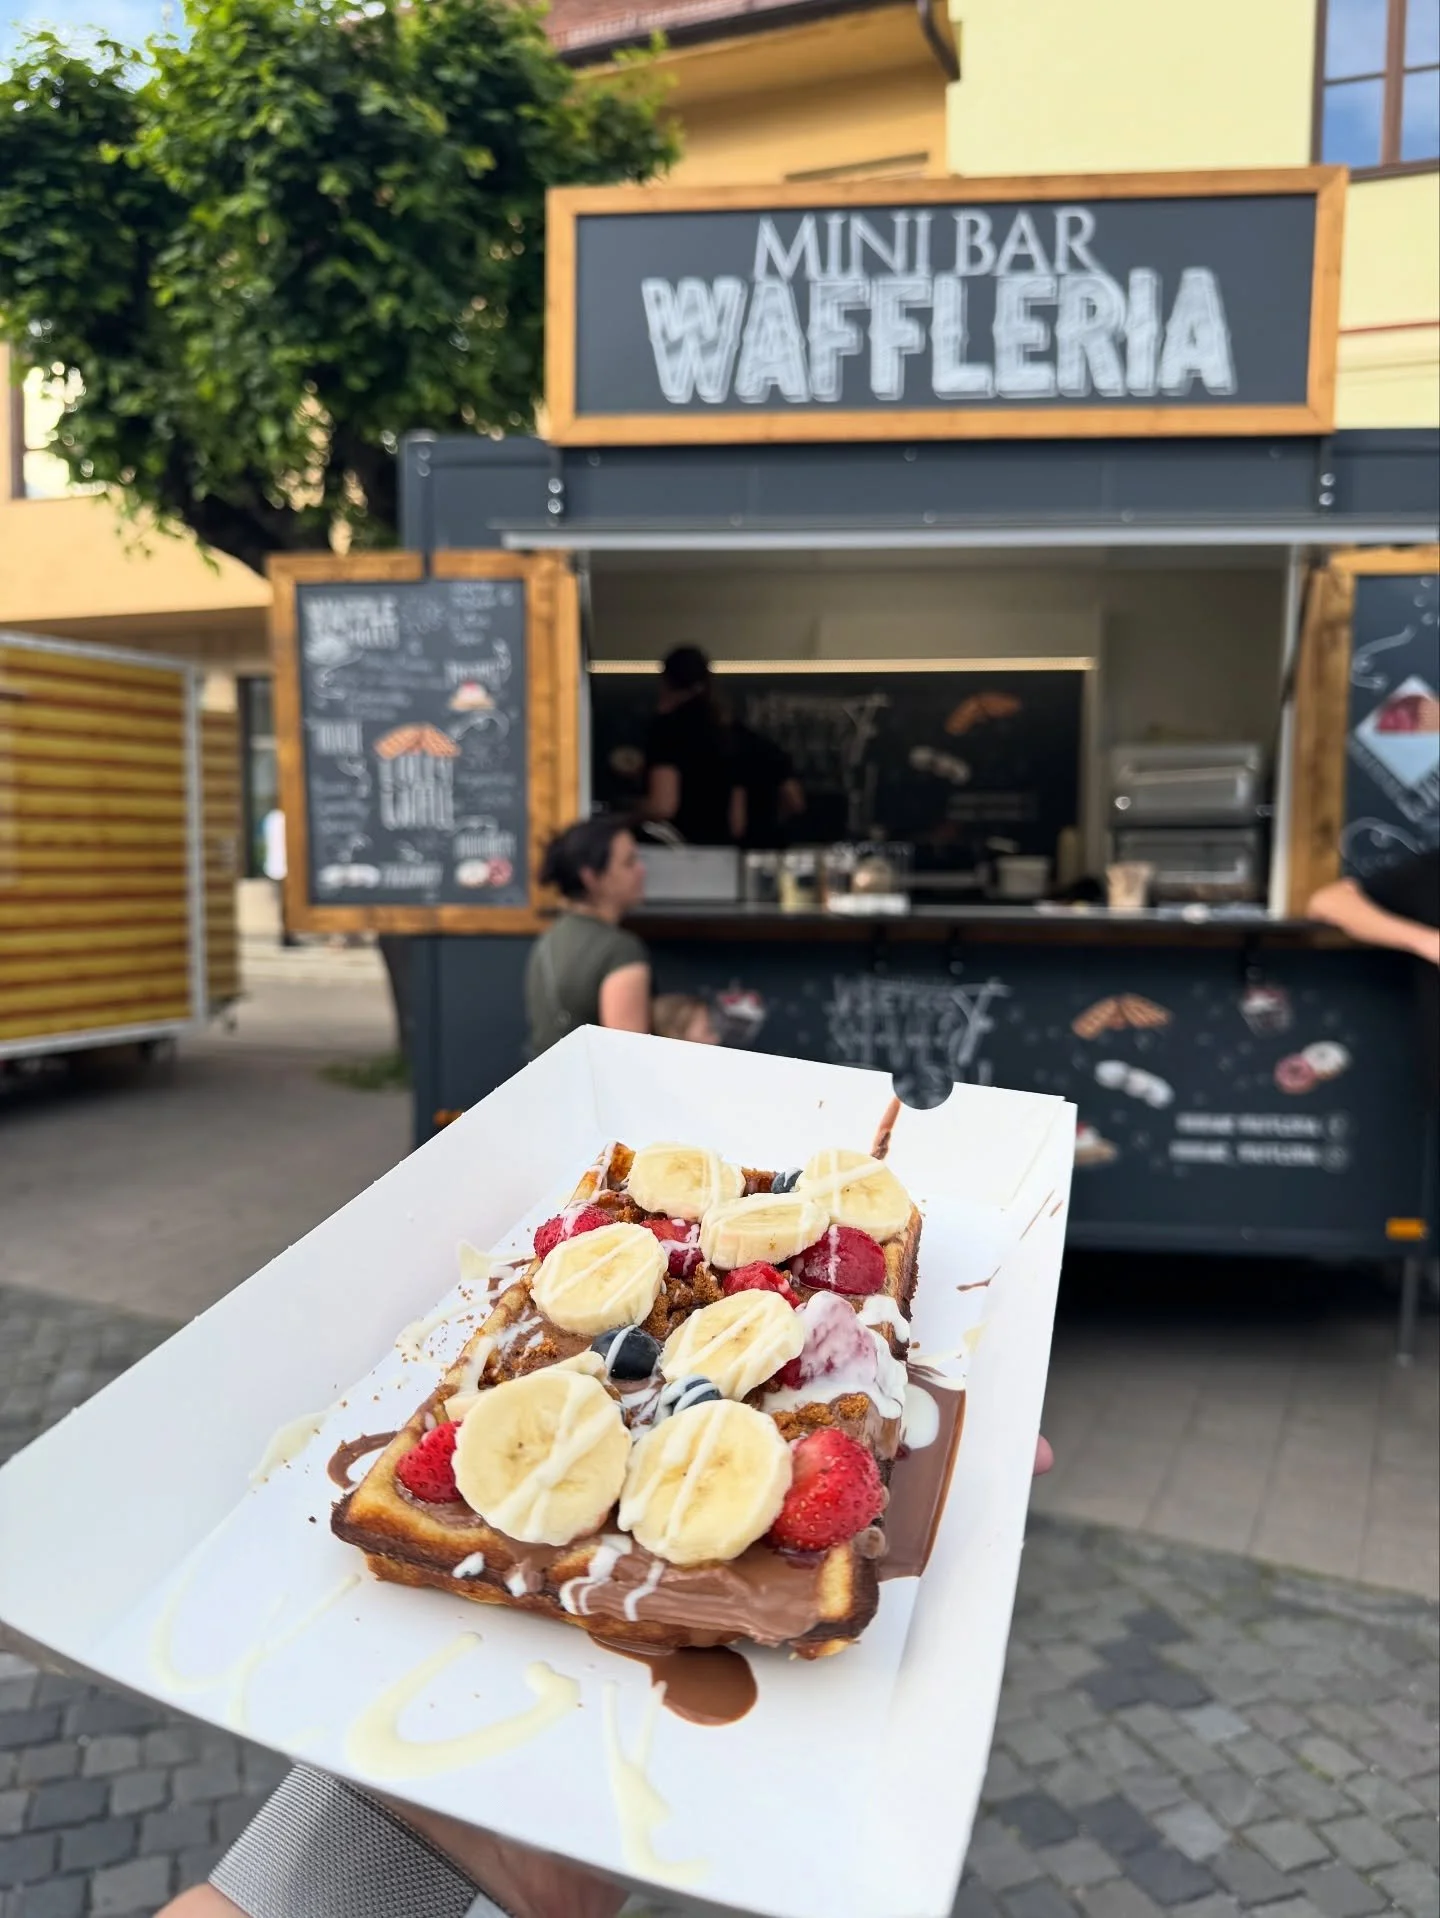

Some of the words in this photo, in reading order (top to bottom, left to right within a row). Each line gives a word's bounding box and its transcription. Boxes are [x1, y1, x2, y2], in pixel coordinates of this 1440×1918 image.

[754, 211, 935, 282] MINI
[953, 207, 1101, 278] BAR
[640, 268, 1236, 404] WAFFLERIA
